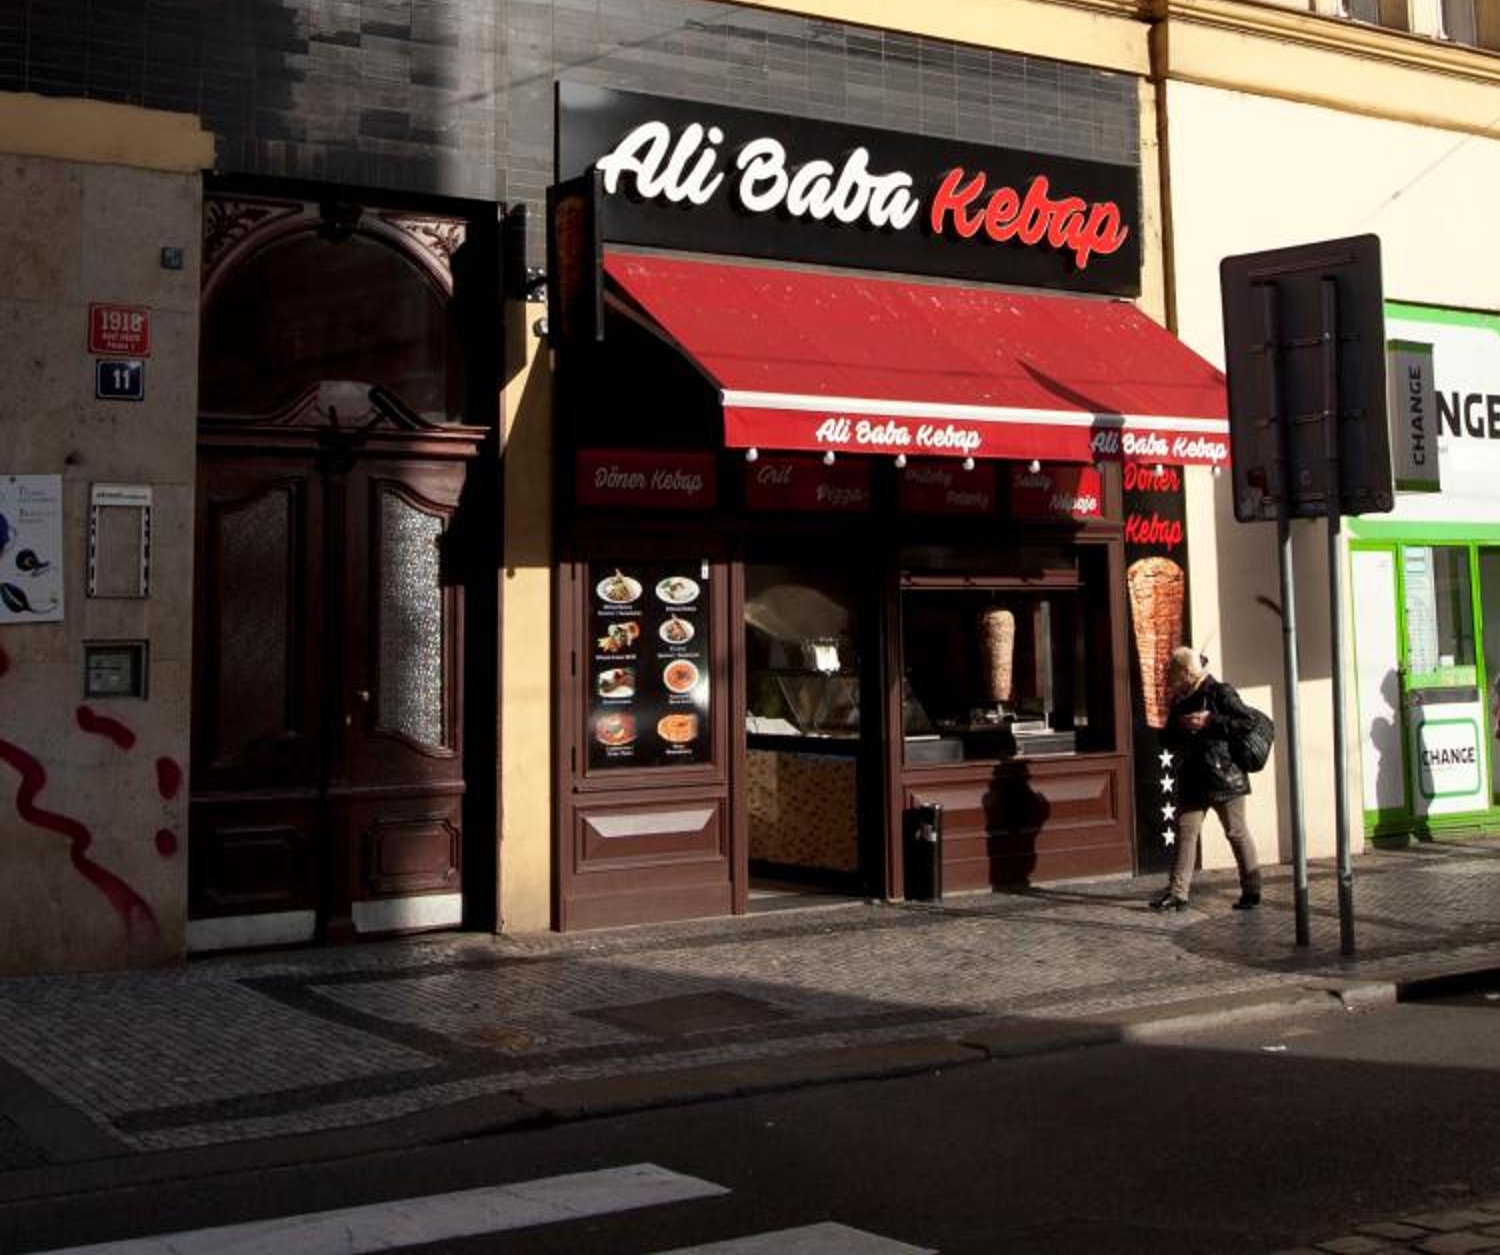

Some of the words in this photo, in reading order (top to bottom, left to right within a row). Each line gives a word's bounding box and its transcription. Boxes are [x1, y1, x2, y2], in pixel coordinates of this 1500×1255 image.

[596, 121, 724, 205] Ali
[736, 138, 918, 230] Baba
[931, 165, 1128, 270] Kebap
[102, 311, 141, 332] 1918
[113, 368, 130, 391] 11
[1407, 365, 1426, 467] CHANGE
[816, 417, 851, 444] Ali
[855, 420, 911, 446] Baba
[916, 424, 982, 455] Kebap
[1091, 431, 1119, 455] Ali
[1121, 432, 1169, 456] Baba
[1173, 435, 1228, 463] Kebap
[1125, 512, 1183, 551] Kebap
[1424, 746, 1475, 766] CHANGE
